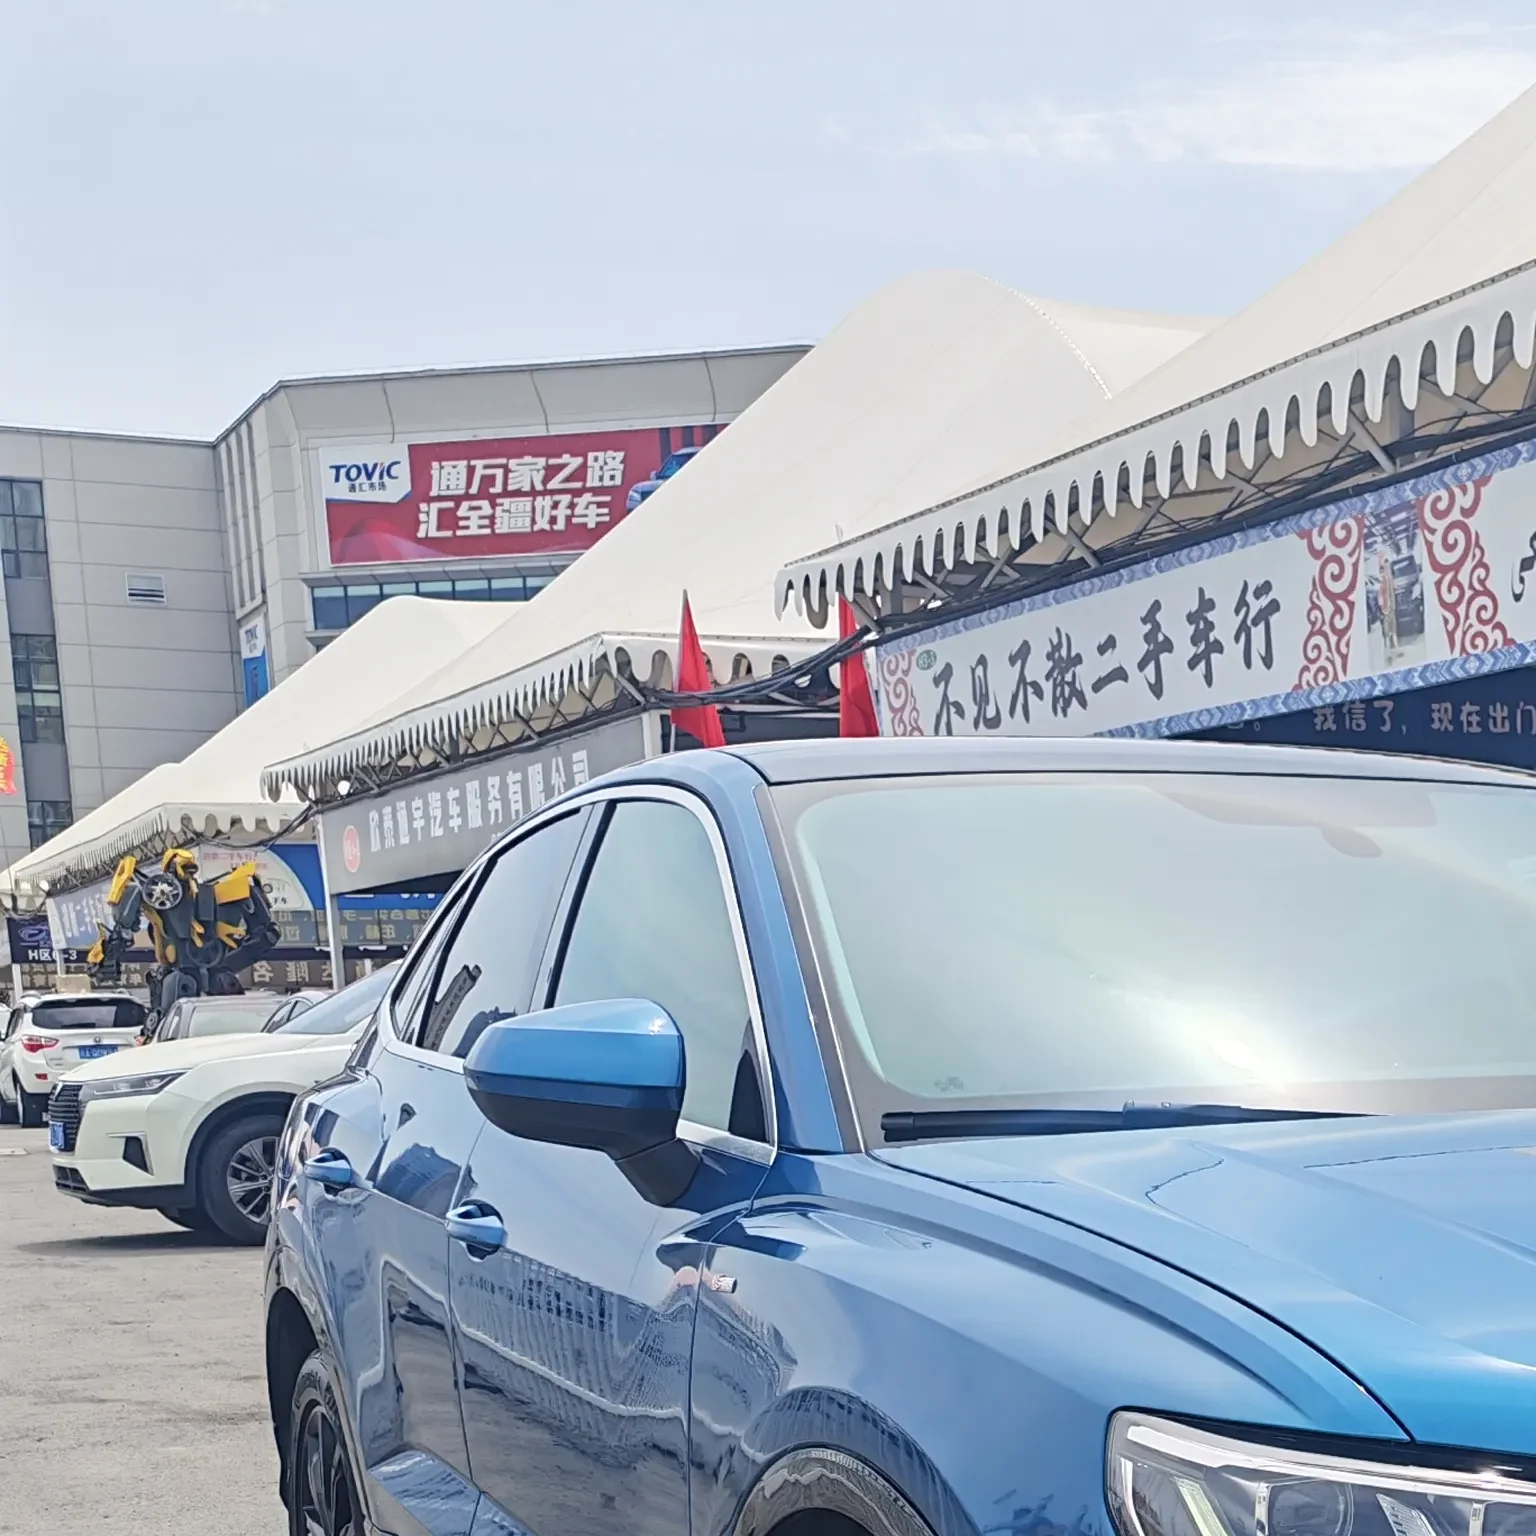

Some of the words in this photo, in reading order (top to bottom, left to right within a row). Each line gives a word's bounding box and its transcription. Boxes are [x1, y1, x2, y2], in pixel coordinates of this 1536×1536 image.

[329, 461, 402, 484] TOVIC
[430, 450, 627, 497] 通万家之路
[416, 493, 612, 539] 汇全疆好车
[933, 580, 1281, 736] 不见不散二手车行
